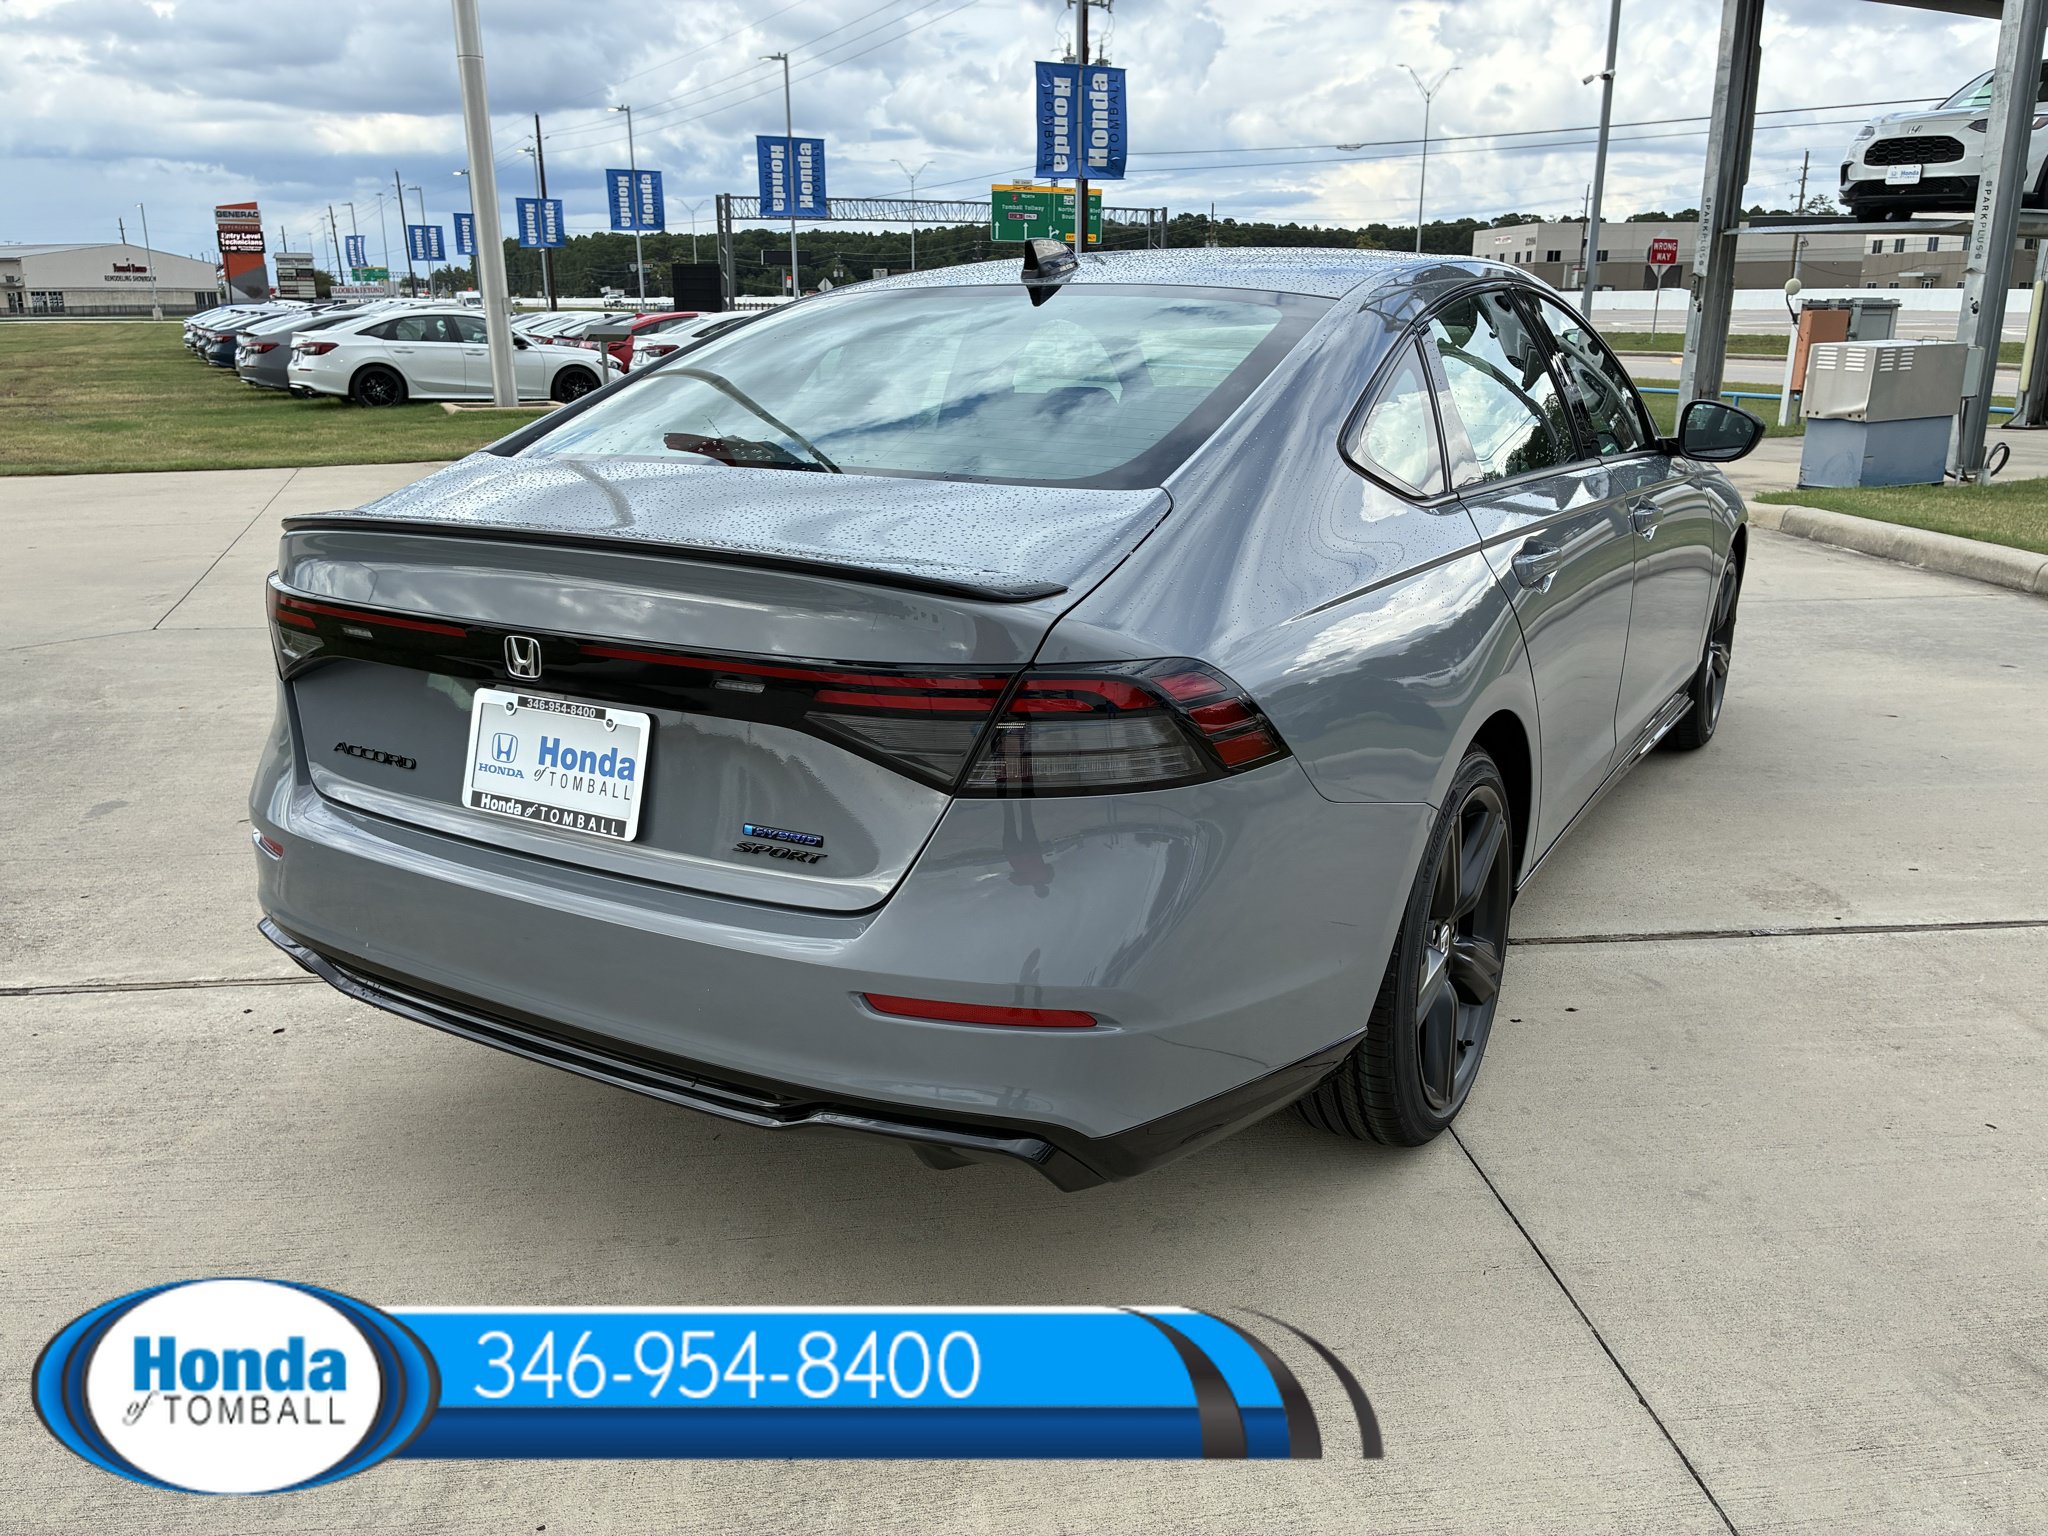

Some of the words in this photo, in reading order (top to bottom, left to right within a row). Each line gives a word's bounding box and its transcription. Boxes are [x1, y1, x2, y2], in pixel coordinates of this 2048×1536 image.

[1044, 92, 1053, 170] TOMBALL
[1054, 77, 1071, 172] Honda
[1088, 73, 1108, 166] Honda
[1109, 76, 1120, 155] TOMBALL
[770, 145, 786, 211] Honda
[798, 143, 814, 208] Honda
[216, 210, 259, 218] GENERAC
[617, 176, 631, 227] Honda
[640, 174, 654, 225] Honda
[1975, 188, 1992, 252] PARKPLUS
[429, 227, 439, 258] Honda
[461, 217, 472, 253] Honda
[525, 203, 538, 245] Honda
[544, 201, 557, 243] Honda
[414, 228, 425, 259] Honda
[1653, 242, 1677, 251] WRONG
[1656, 253, 1671, 261] WAY
[333, 741, 417, 770] ACCORD
[478, 762, 525, 779] HONDA
[537, 735, 636, 782] Honda
[533, 766, 550, 782] of
[550, 771, 631, 801] TOMBALL
[480, 793, 522, 816] Honda
[524, 803, 538, 817] of
[539, 806, 619, 836] TOMBALL
[753, 825, 819, 845] HYBRID
[732, 840, 828, 864] SPORT
